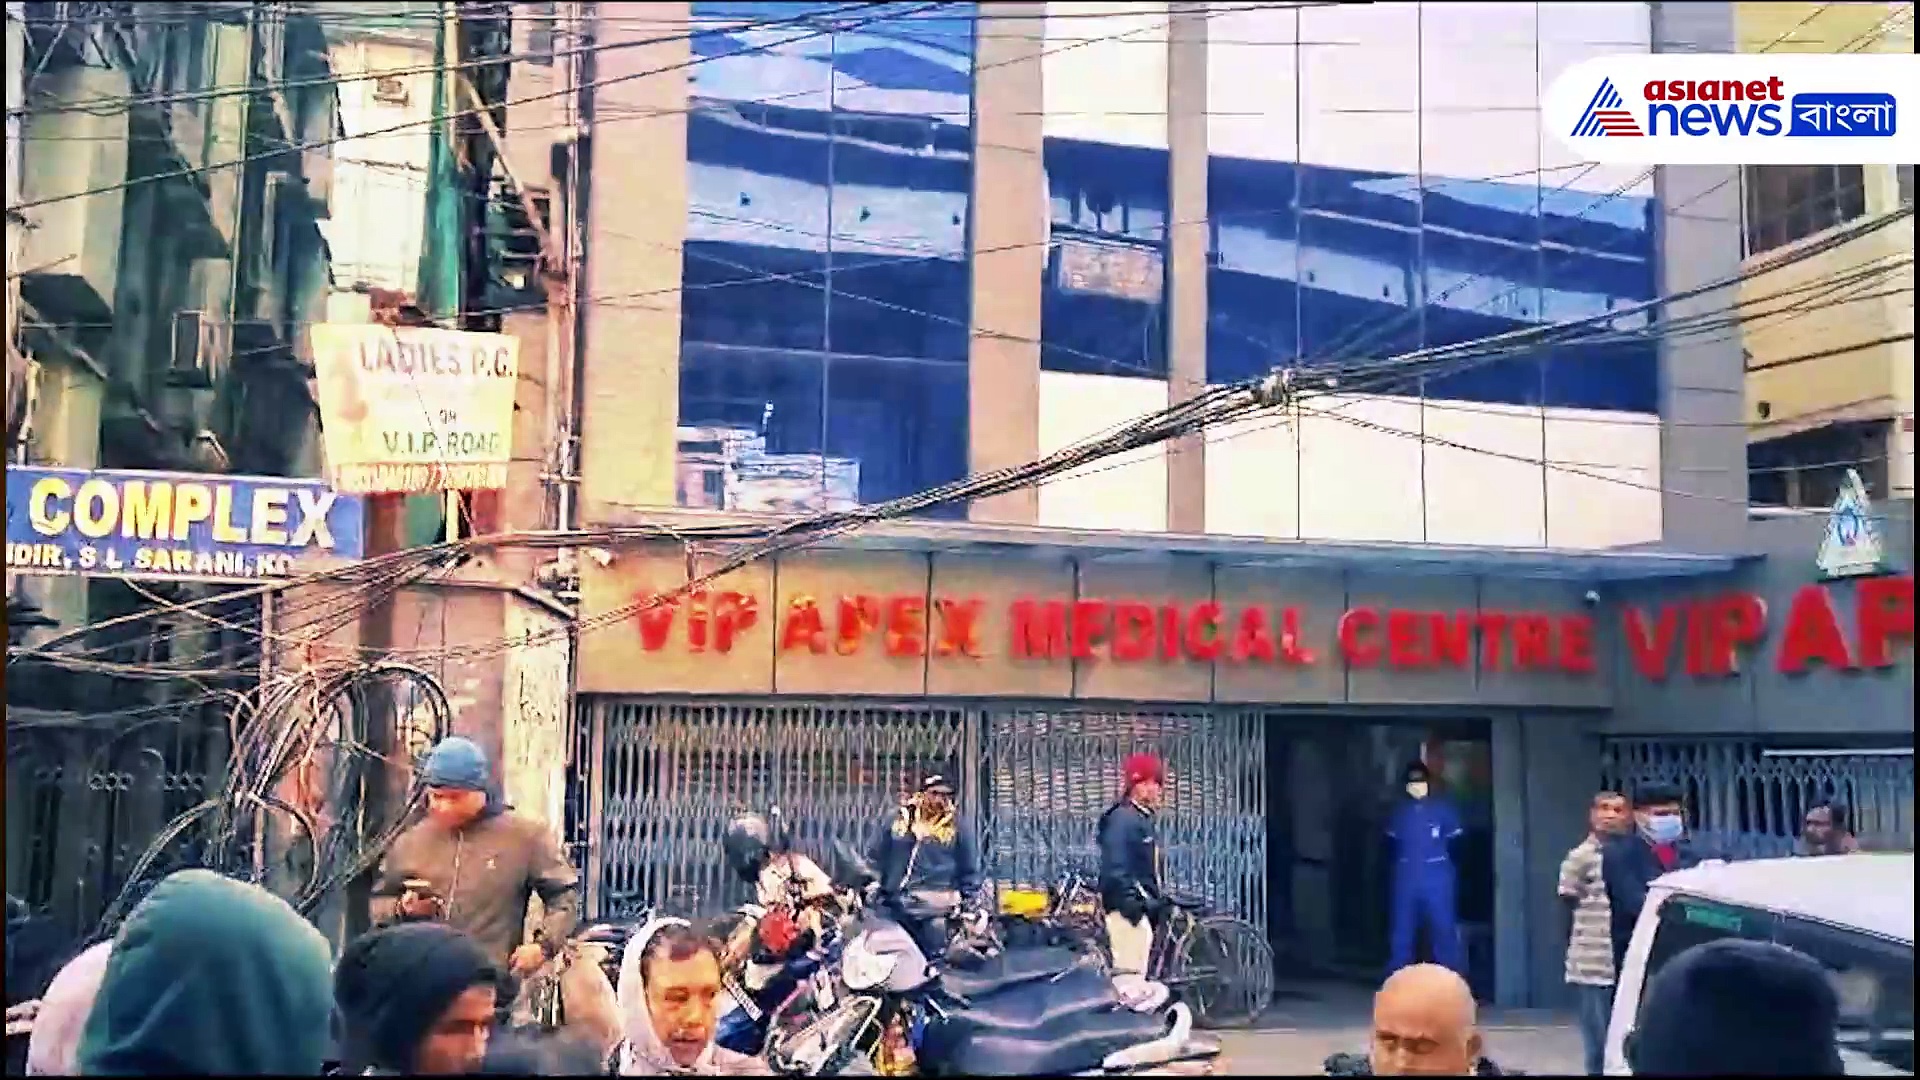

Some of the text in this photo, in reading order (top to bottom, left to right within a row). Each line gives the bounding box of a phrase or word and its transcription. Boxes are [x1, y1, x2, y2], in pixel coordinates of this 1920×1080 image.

[359, 336, 462, 376] LADIES
[29, 477, 336, 548] COMPLEX
[79, 545, 97, 568] S
[106, 547, 123, 570] L
[783, 593, 984, 657] APEX
[1009, 597, 1315, 665] MEDICAL
[1338, 606, 1597, 671] CENTRE
[1622, 592, 1766, 682] VIP
